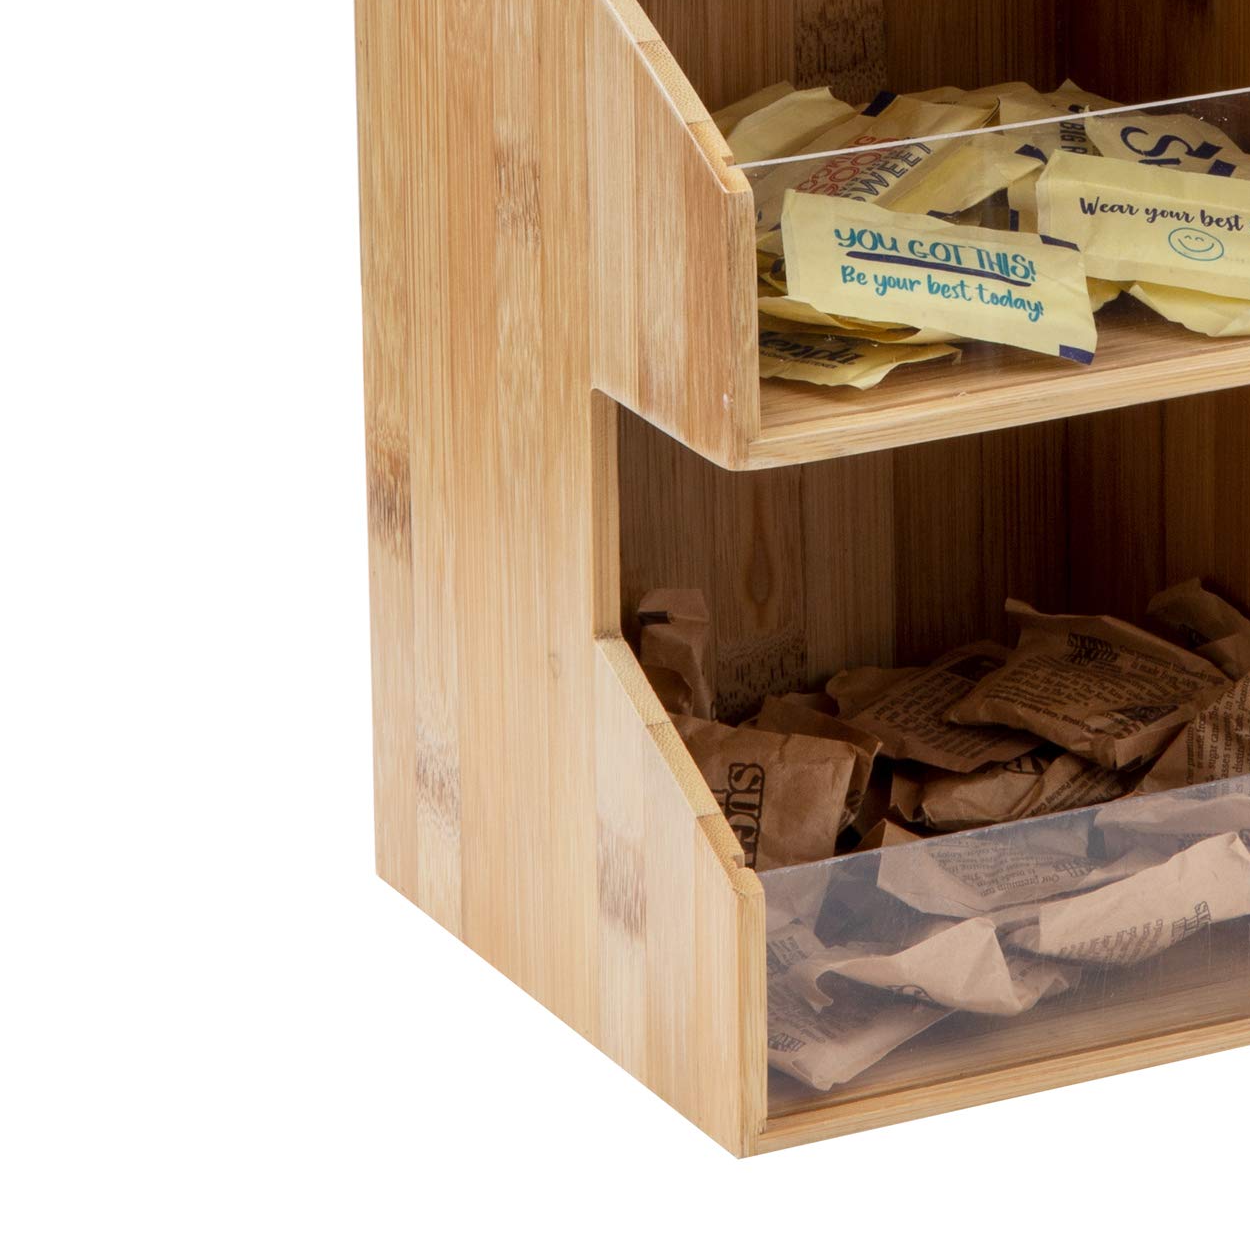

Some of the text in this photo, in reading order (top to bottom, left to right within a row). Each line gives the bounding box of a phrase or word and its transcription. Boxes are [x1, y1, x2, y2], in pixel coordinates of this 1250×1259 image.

[1079, 196, 1140, 216] Wear
[1144, 207, 1195, 224] your
[1199, 209, 1244, 231] best
[834, 227, 1037, 282] YOU GOT THIS!
[840, 264, 1045, 323] Be your best today!
[1205, 744, 1219, 769] sugar
